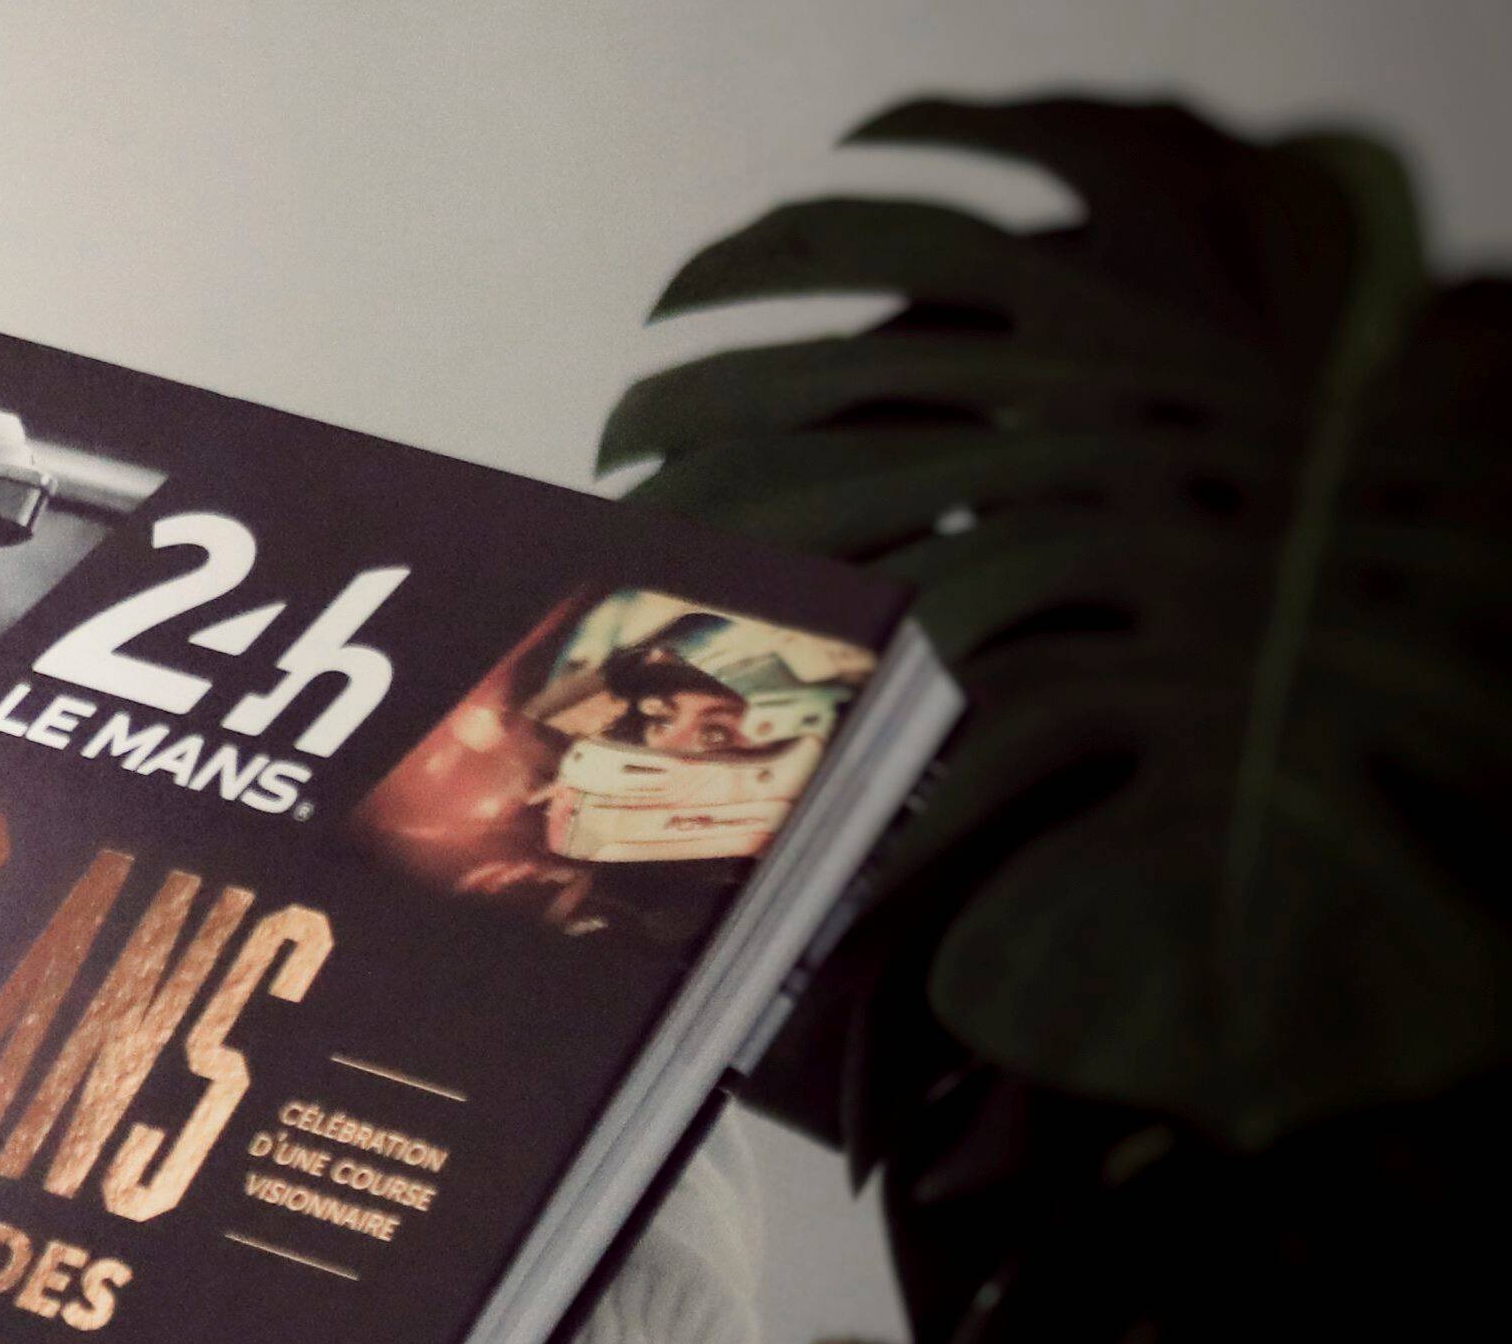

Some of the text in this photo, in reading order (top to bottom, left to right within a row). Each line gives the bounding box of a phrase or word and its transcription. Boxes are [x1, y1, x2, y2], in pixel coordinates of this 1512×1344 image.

[32, 512, 412, 758] 24h
[248, 1129, 438, 1212] D'UNE COURSE
[278, 1098, 450, 1174] CÉLÉBRATION
[243, 1170, 402, 1242] VISIONNAIRE
